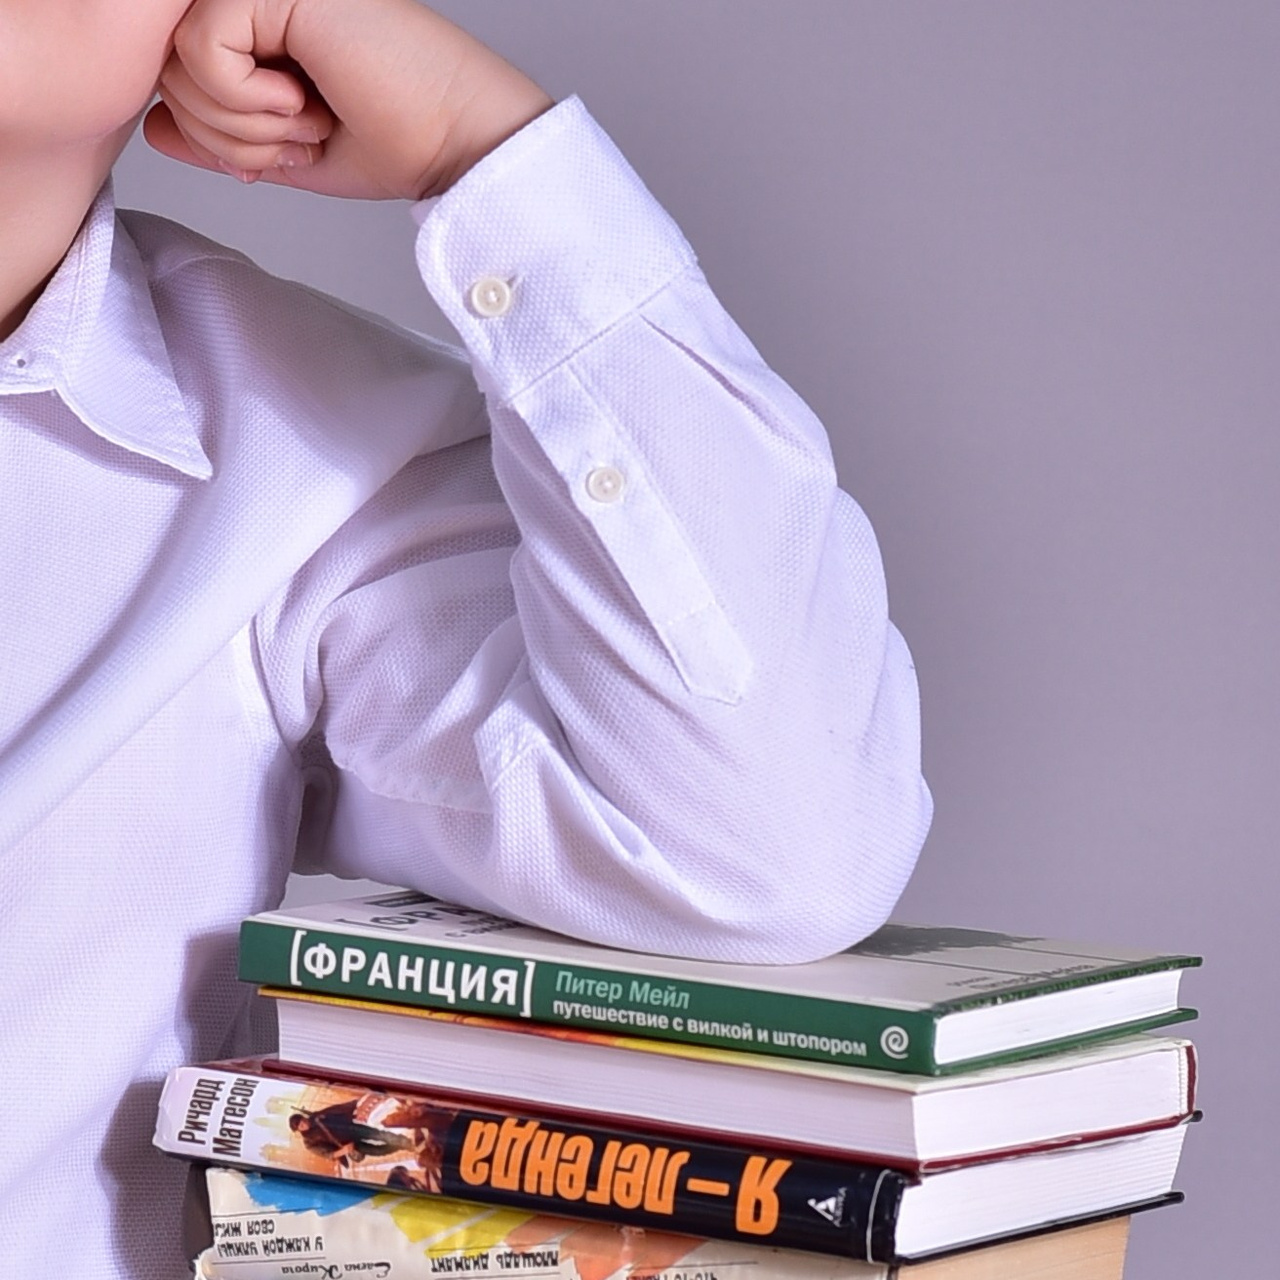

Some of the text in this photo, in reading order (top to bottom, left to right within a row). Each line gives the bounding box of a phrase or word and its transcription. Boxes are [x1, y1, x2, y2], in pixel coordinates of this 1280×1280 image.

[289, 929, 536, 1018] [ФРАНЦИЯ]
[555, 970, 690, 1010] Питер Мейл
[553, 999, 867, 1057] путешествие с вилкой и штопором
[178, 1078, 226, 1145] Ричард
[212, 1078, 260, 1157] Матесон
[459, 1117, 690, 1215] легенда
[735, 1155, 793, 1235] Я
[217, 1236, 323, 1257] У КАЖДОЙ УЛИЦЫ
[247, 1219, 275, 1236] СВОЯ
[344, 1262, 391, 1279] Елена
[431, 1251, 559, 1273] ПЛОЩАДЬ ДИАМАНТ
